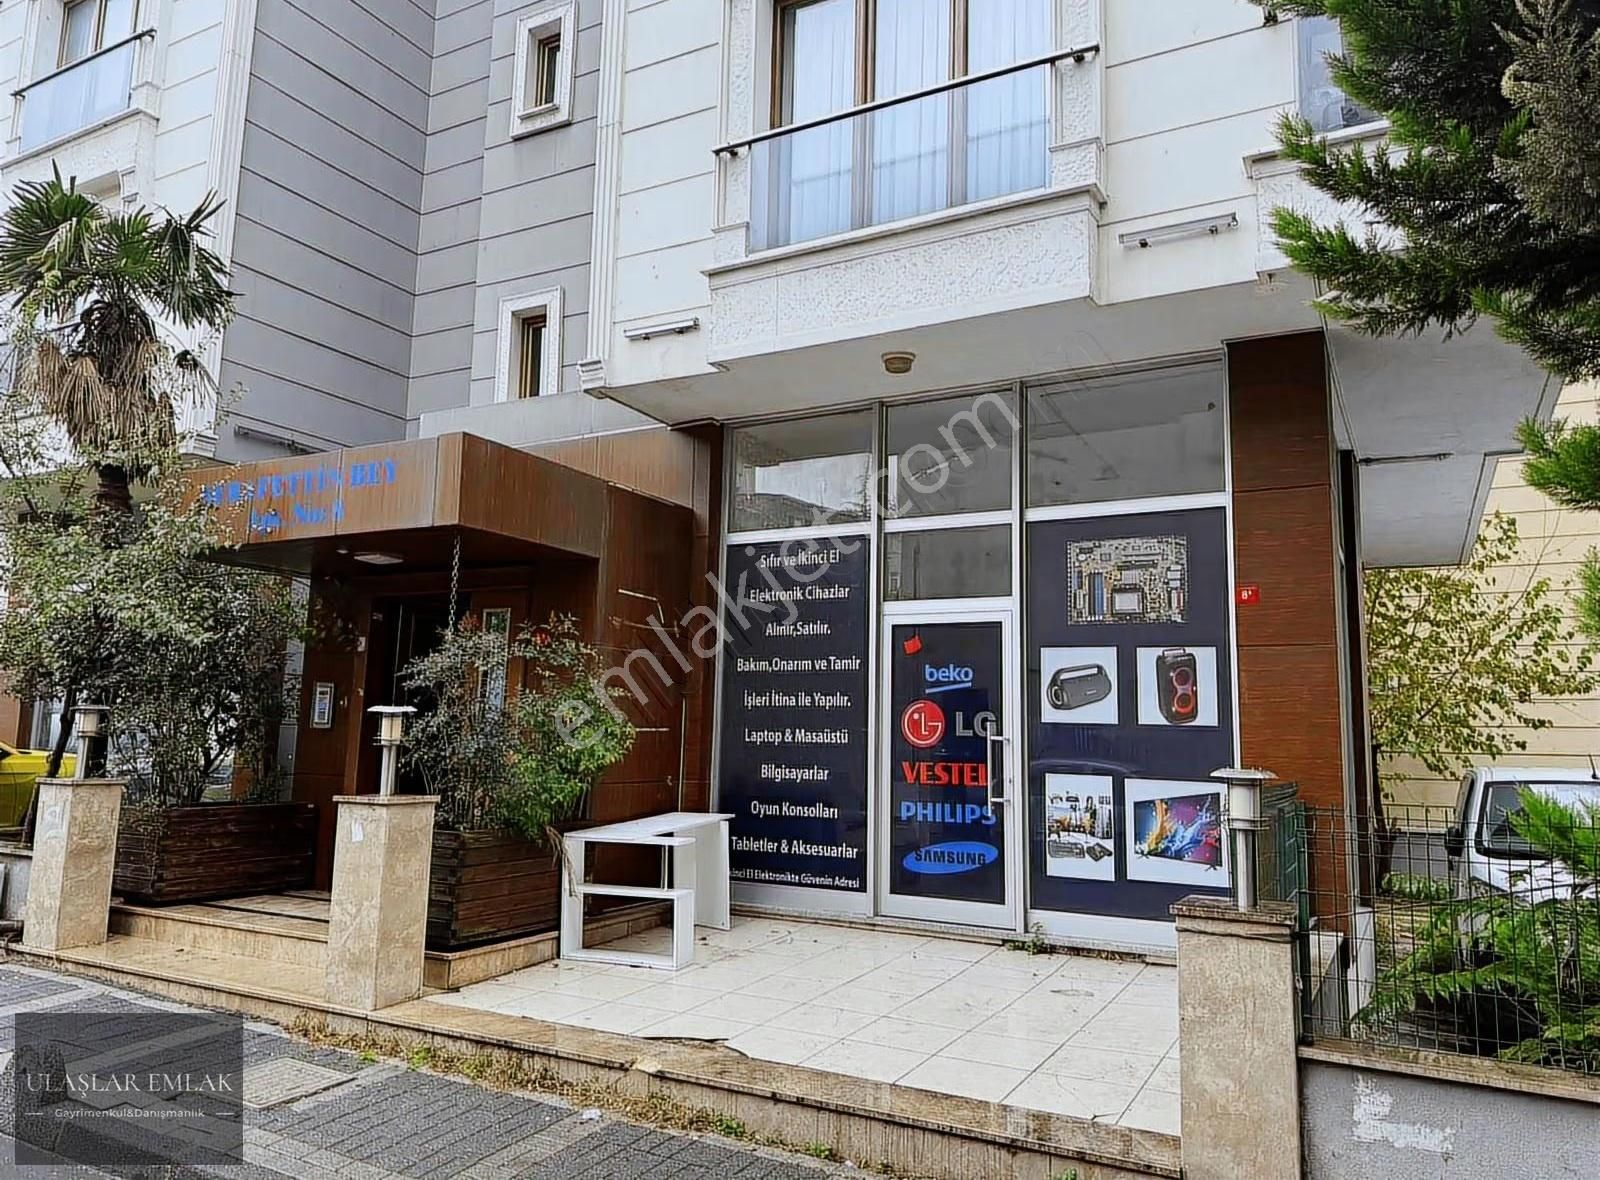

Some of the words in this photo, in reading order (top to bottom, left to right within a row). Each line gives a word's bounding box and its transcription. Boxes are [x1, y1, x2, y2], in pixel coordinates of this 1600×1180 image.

[351, 458, 398, 489] BEY
[760, 553, 782, 568] Sıfır
[784, 554, 796, 566] ve
[830, 550, 840, 563] El
[750, 586, 803, 602] Elektronik
[805, 584, 850, 599] Cihazlar
[737, 657, 812, 673] Bakım,Onarım
[814, 659, 828, 670] ve
[829, 655, 861, 671] Tamir
[925, 663, 973, 682] beko
[744, 689, 769, 710] İşleri
[772, 689, 796, 707] İtina
[798, 691, 811, 707] ile
[813, 692, 852, 710] Yapılır.
[955, 711, 997, 737] LG
[744, 728, 782, 745] Laptop
[784, 728, 793, 742] &
[795, 728, 849, 744] Masaüstü
[761, 764, 830, 782] Bilgisayarlar
[902, 761, 992, 786] VESTEL
[751, 800, 780, 818] Oyun
[782, 801, 838, 819] Konsolları
[900, 800, 997, 825] PHILIPS
[731, 836, 778, 853] Tabletler
[780, 839, 790, 854] &
[791, 839, 859, 859] Aksesuarlar
[914, 846, 987, 866] SAMSUNG
